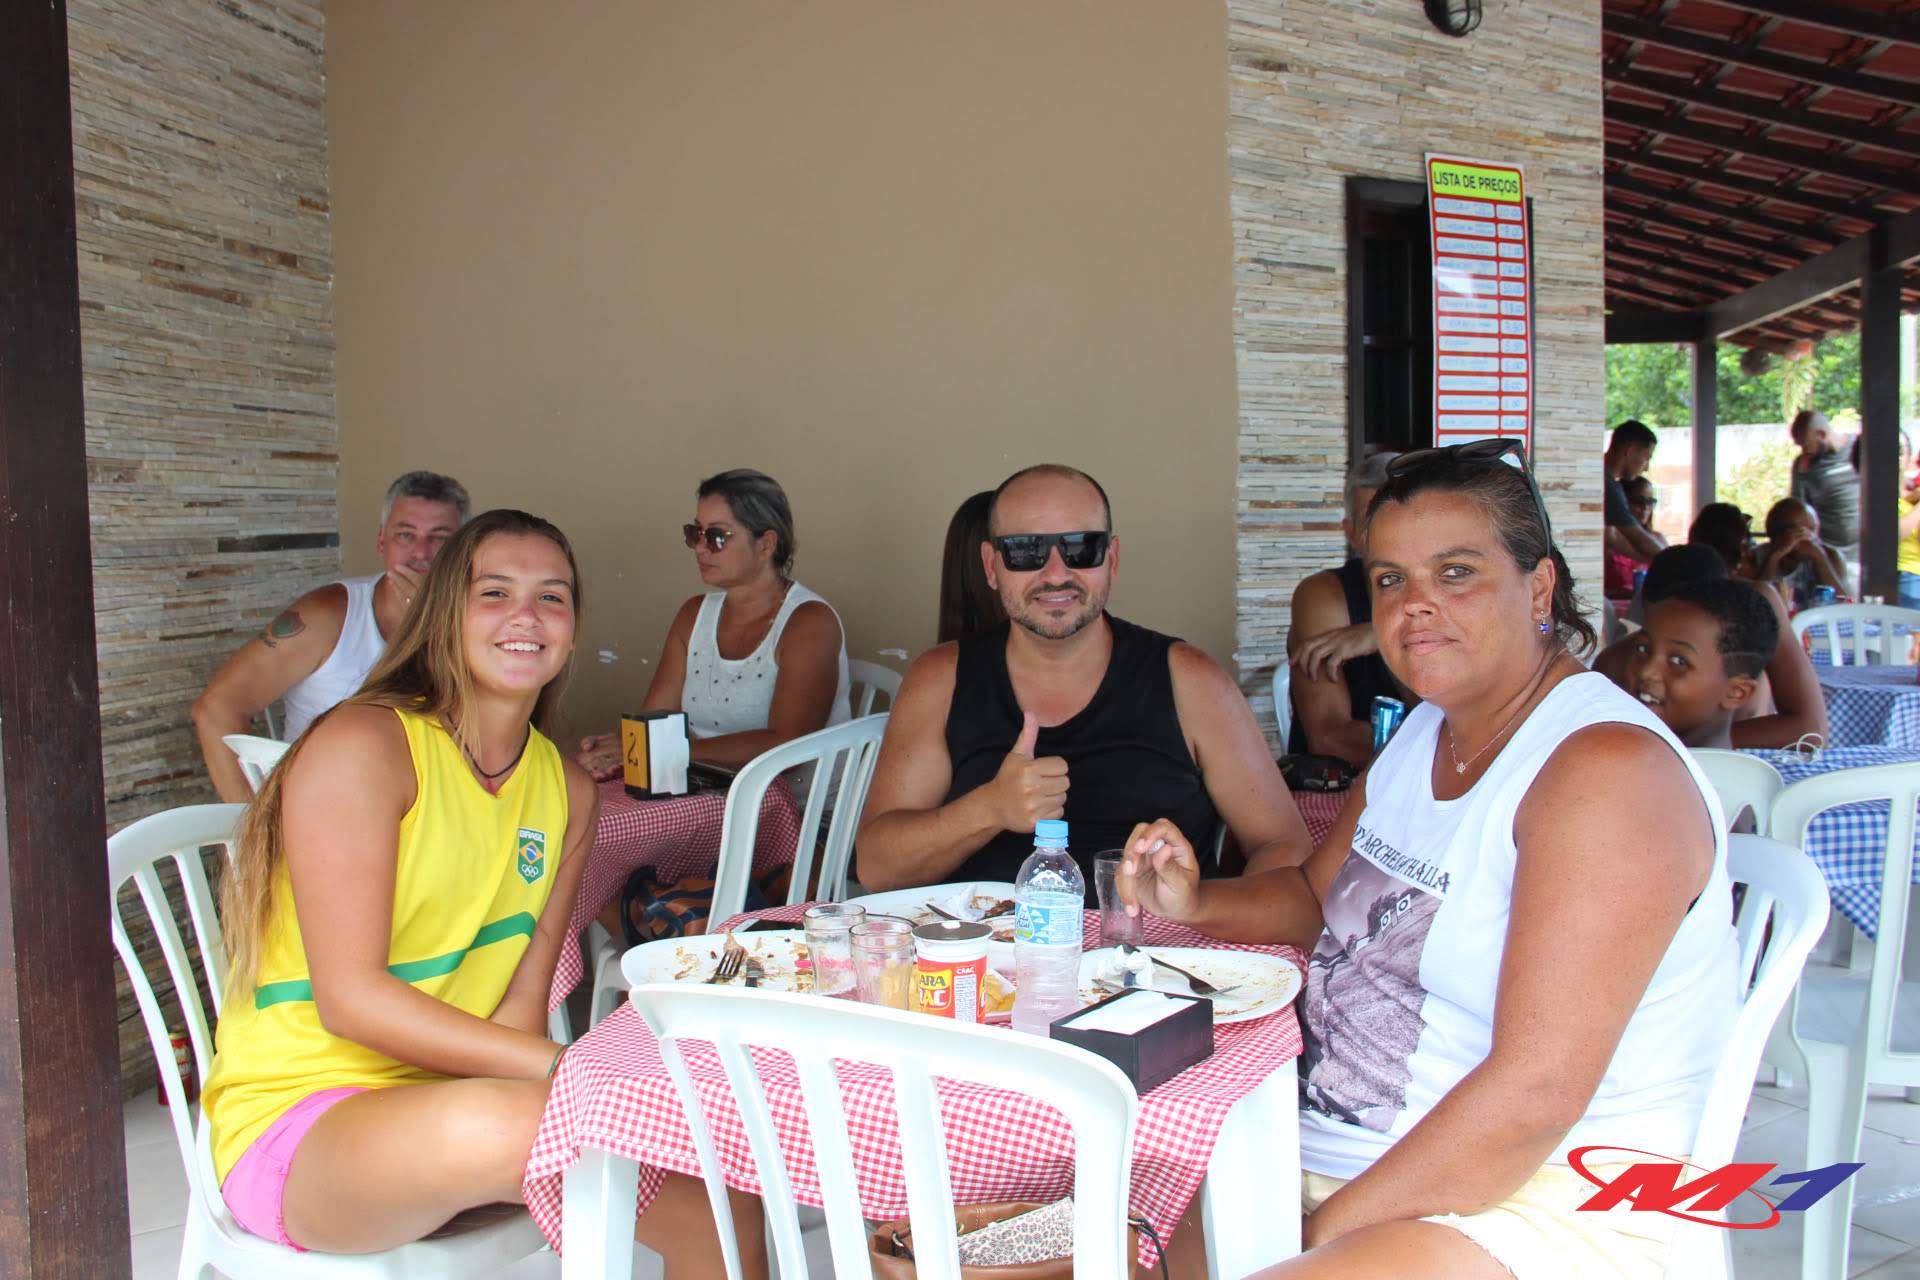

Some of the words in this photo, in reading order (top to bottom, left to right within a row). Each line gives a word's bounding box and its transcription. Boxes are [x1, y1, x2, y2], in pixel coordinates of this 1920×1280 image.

[1434, 171, 1460, 186] LISTA
[1463, 174, 1476, 189] DE
[1478, 176, 1519, 195] PREÇOS
[626, 731, 639, 767] 2
[520, 829, 545, 842] BRASIL
[956, 966, 975, 975] CRAC
